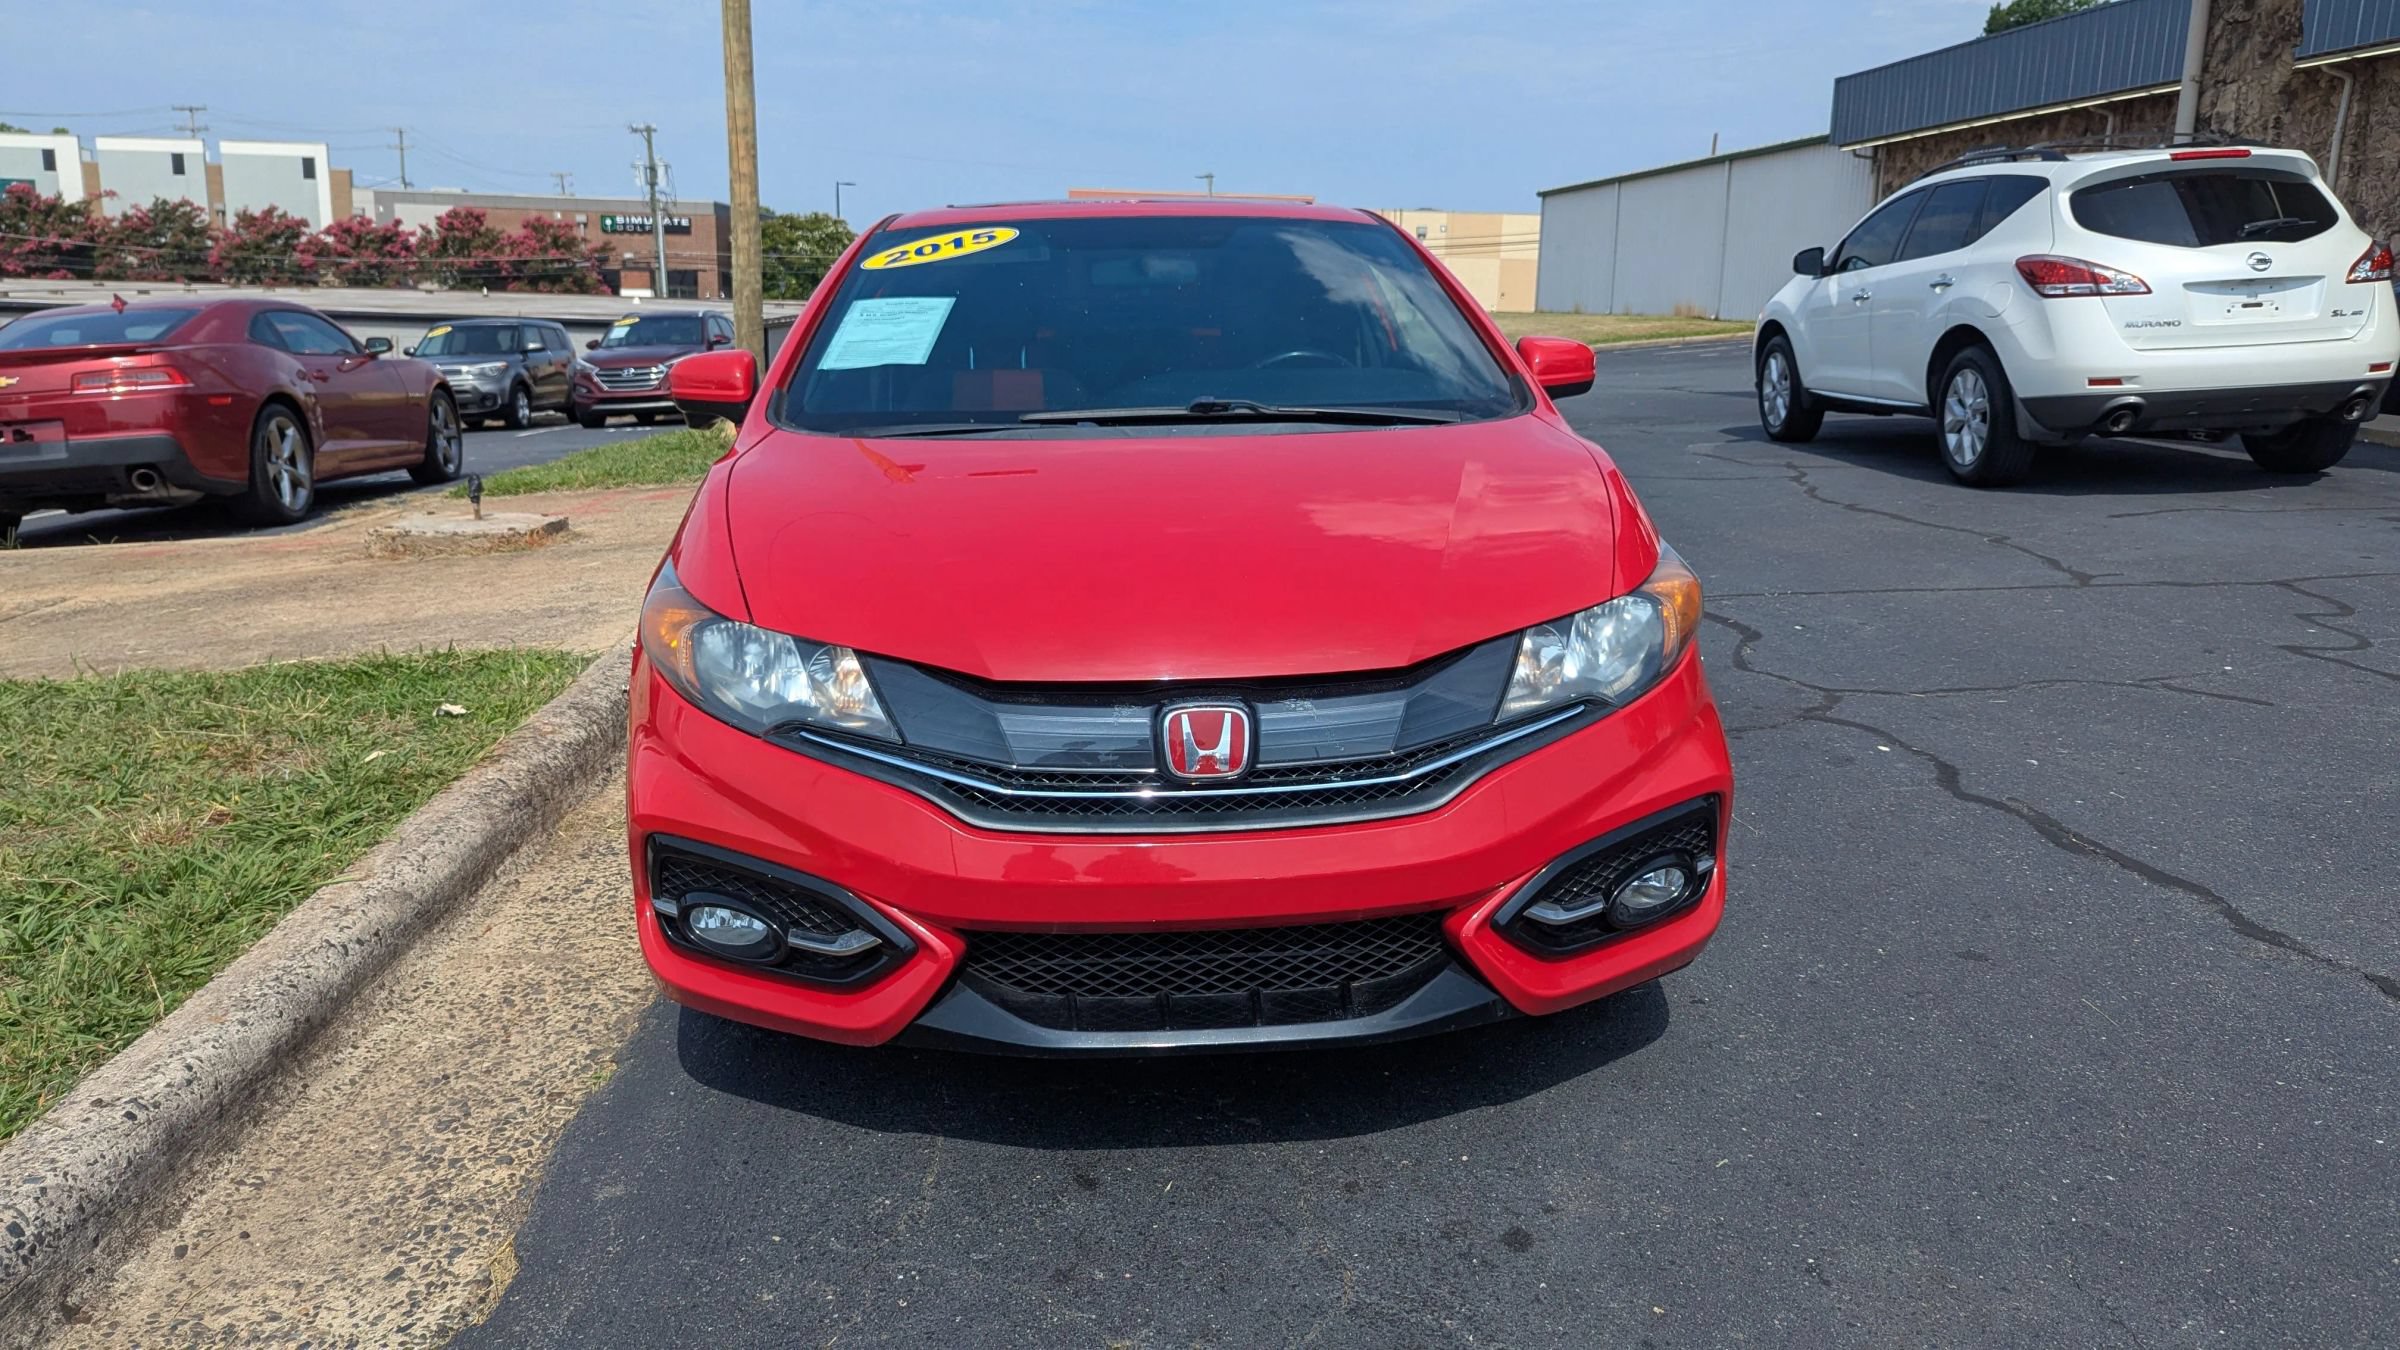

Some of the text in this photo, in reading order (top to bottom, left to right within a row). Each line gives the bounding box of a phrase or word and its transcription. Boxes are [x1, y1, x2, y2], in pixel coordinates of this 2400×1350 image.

[616, 215, 690, 226] SIMUATE
[883, 230, 998, 267] 2015
[2330, 309, 2347, 318] SL
[2124, 320, 2182, 329] MURANO
